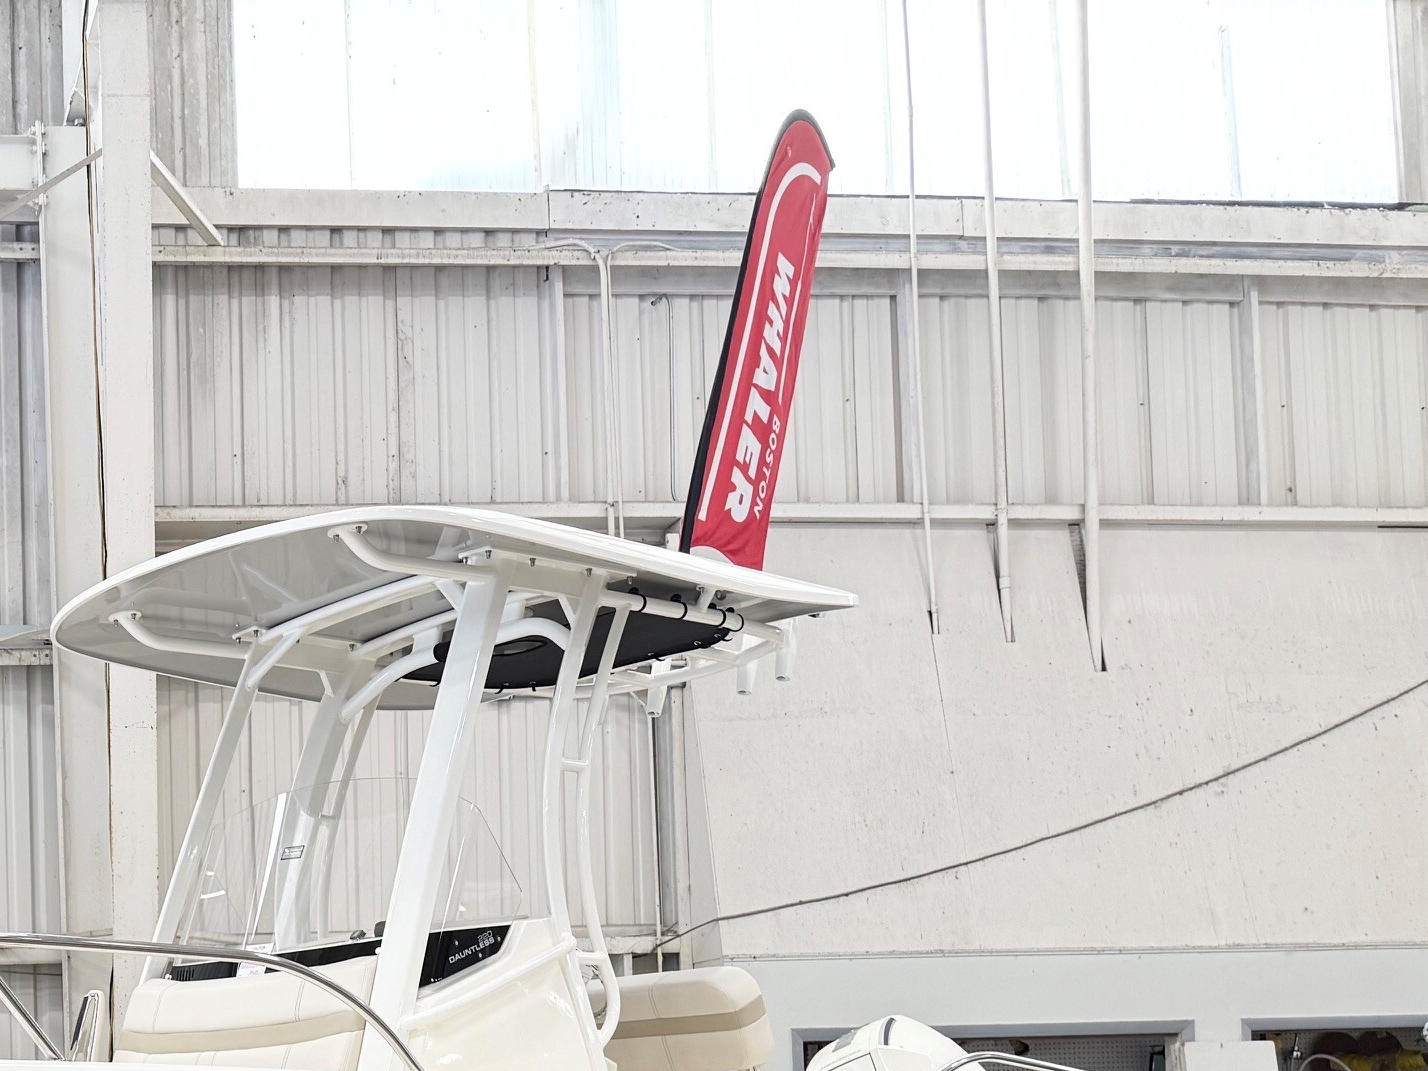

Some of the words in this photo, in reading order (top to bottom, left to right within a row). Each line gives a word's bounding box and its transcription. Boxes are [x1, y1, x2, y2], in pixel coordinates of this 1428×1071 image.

[724, 251, 795, 523] WHALER
[753, 413, 781, 520] BOSTON
[448, 937, 495, 964] DAUNTLESS
[477, 930, 493, 943] 220
